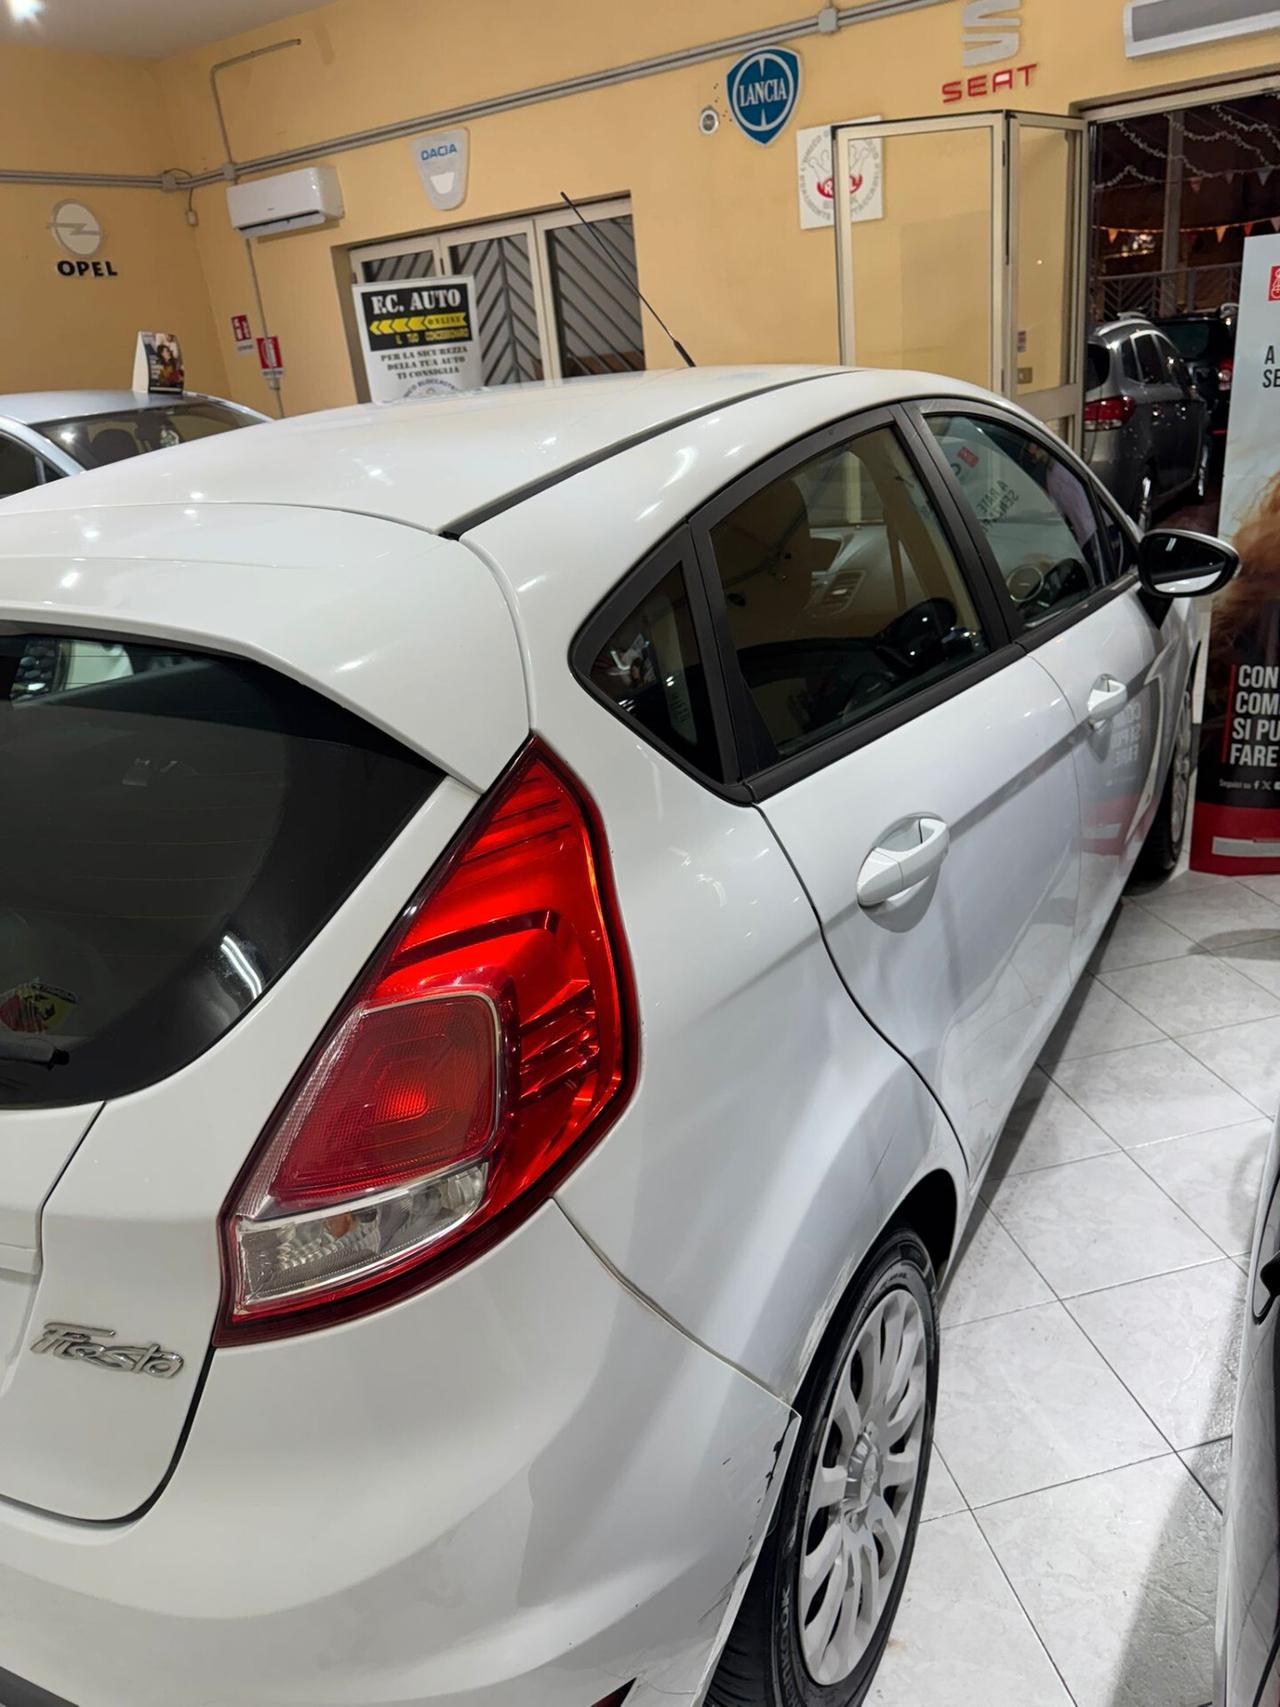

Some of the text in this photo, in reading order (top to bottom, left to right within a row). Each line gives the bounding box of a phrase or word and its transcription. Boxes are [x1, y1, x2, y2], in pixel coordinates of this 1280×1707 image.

[739, 77, 788, 107] LANCIA
[942, 63, 1038, 103] SEAT
[421, 143, 458, 161] DACIA
[57, 260, 118, 277] OPEL
[370, 288, 461, 315] F.C. AUTO
[381, 346, 468, 362] PER LA SICUREZZA
[387, 356, 466, 371] DELLA TUA AUTO
[1264, 345, 1276, 365] A
[396, 366, 460, 380] TI CONSIGLIA
[1238, 664, 1279, 689] CON
[1232, 717, 1252, 740] SI
[1230, 743, 1280, 767] FARE
[30, 1321, 185, 1380] Fiesta
